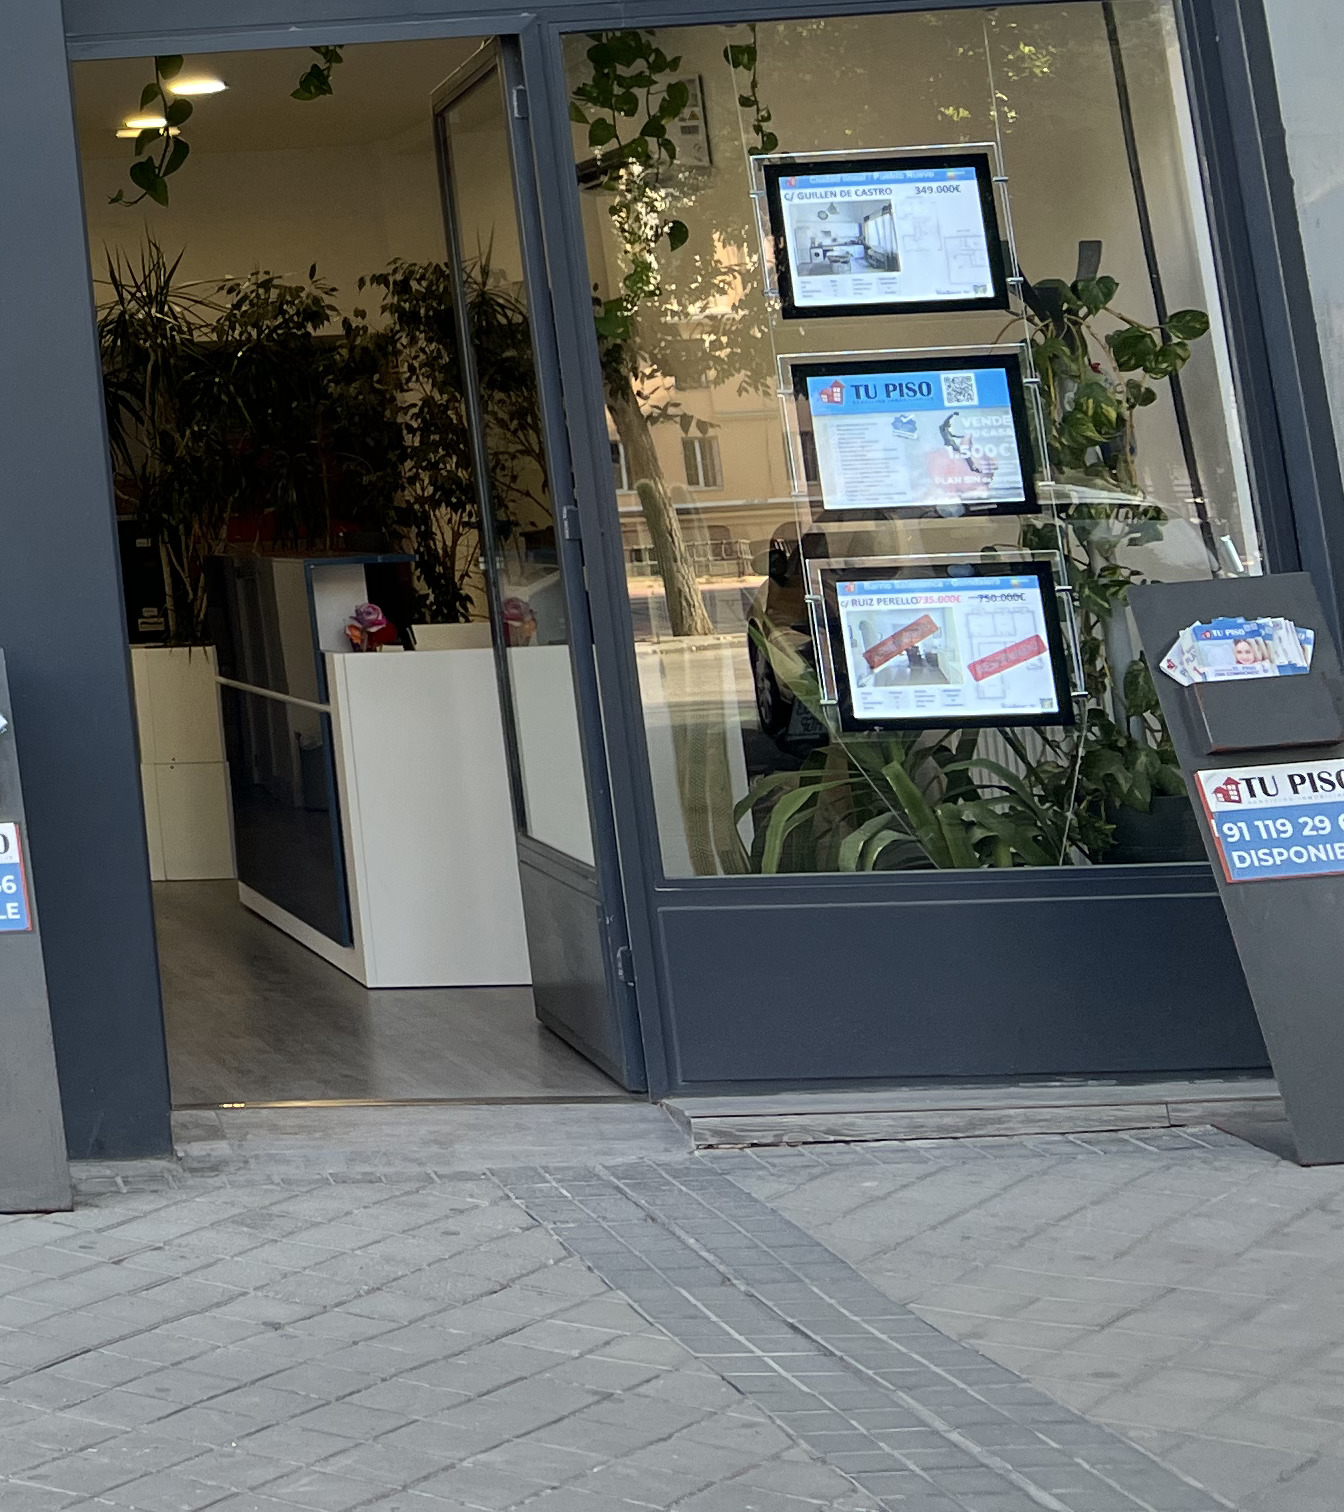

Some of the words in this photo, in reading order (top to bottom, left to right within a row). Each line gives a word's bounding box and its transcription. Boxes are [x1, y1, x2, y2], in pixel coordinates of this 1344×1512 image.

[797, 191, 837, 201] GUILLEN
[840, 189, 852, 198] DE
[854, 188, 893, 198] CASTRO
[850, 384, 878, 400] TU
[884, 381, 932, 399] PISO
[851, 597, 874, 607] RUIZ
[877, 596, 918, 606] PERELLO
[1239, 775, 1279, 799] TU
[1222, 822, 1251, 843] 91
[1253, 819, 1293, 840] 119
[1298, 815, 1332, 837] 29
